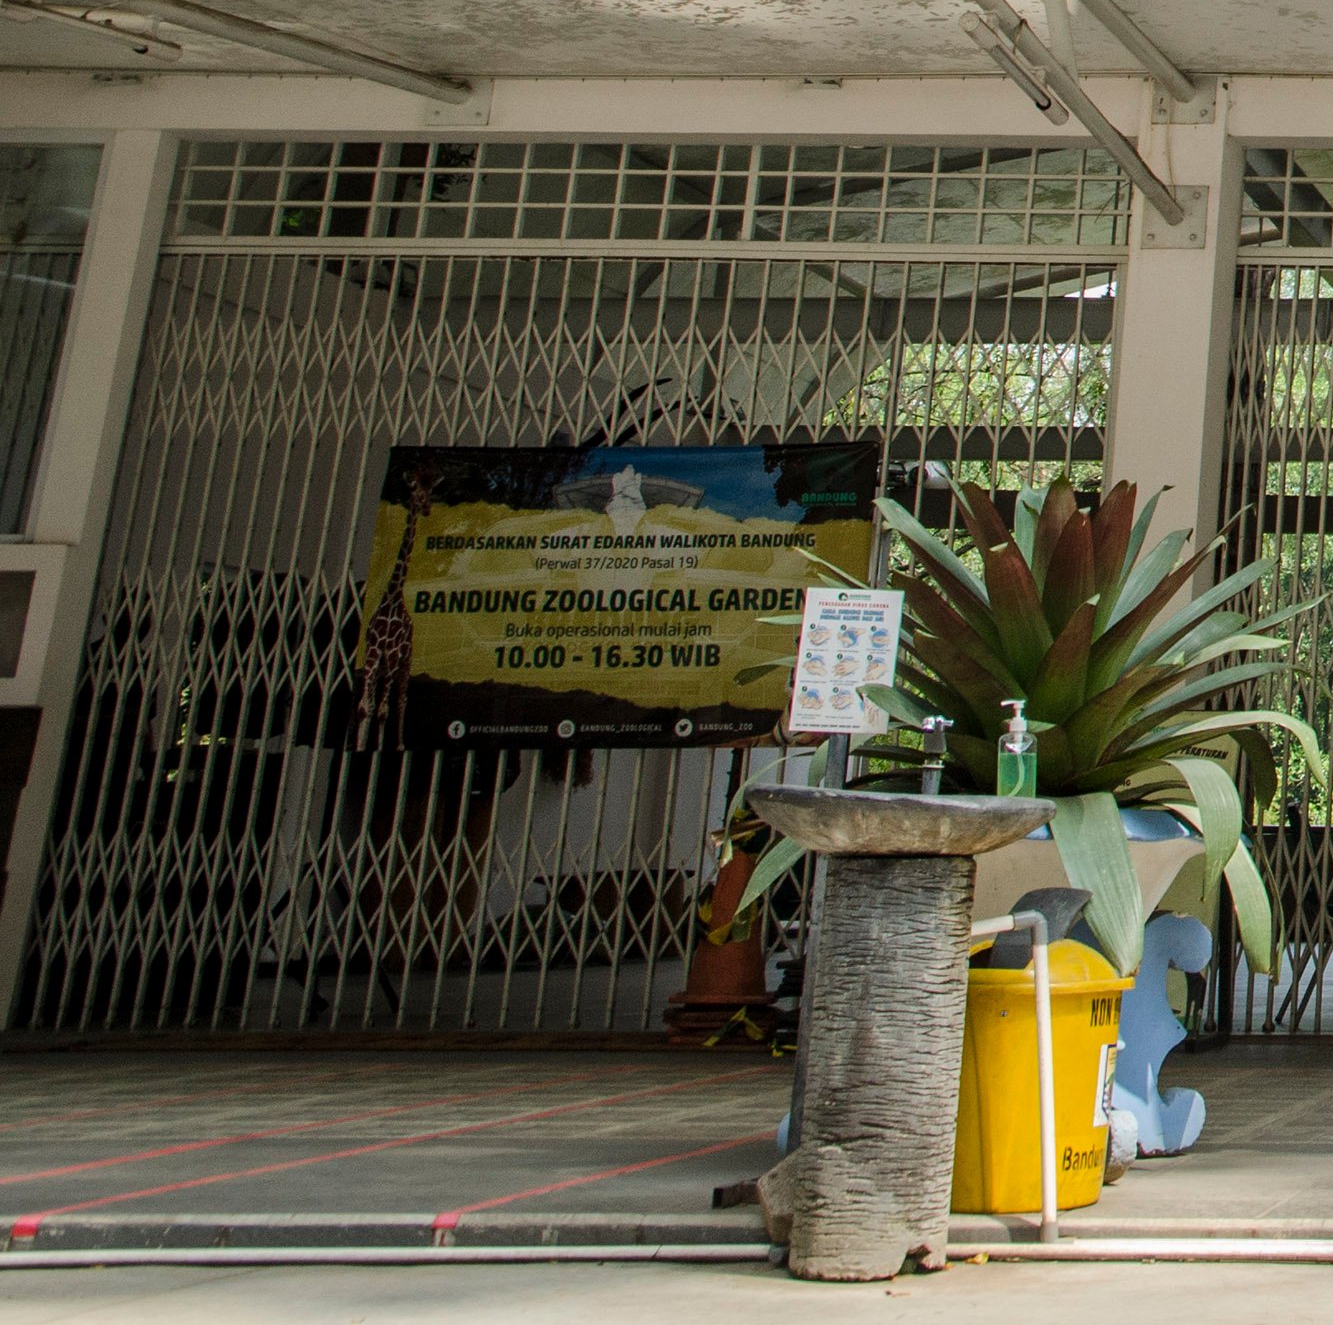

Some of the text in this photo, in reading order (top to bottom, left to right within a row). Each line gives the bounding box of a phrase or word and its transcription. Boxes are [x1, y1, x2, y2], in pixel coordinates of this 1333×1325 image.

[425, 533, 816, 551] BERDASARKAN SURAT EDARAN WALIKOTA BANDUNG
[535, 555, 699, 571] (Perwal 37/2020 Pasal 19)
[414, 589, 536, 614] BANDUNG
[542, 589, 700, 613] ZOOLOGICAL
[506, 622, 712, 640] Buka operasional mulai jam
[494, 645, 565, 669] 10.00
[591, 645, 665, 668] 16.30
[669, 644, 720, 668] WIB
[1090, 997, 1113, 1027] NON
